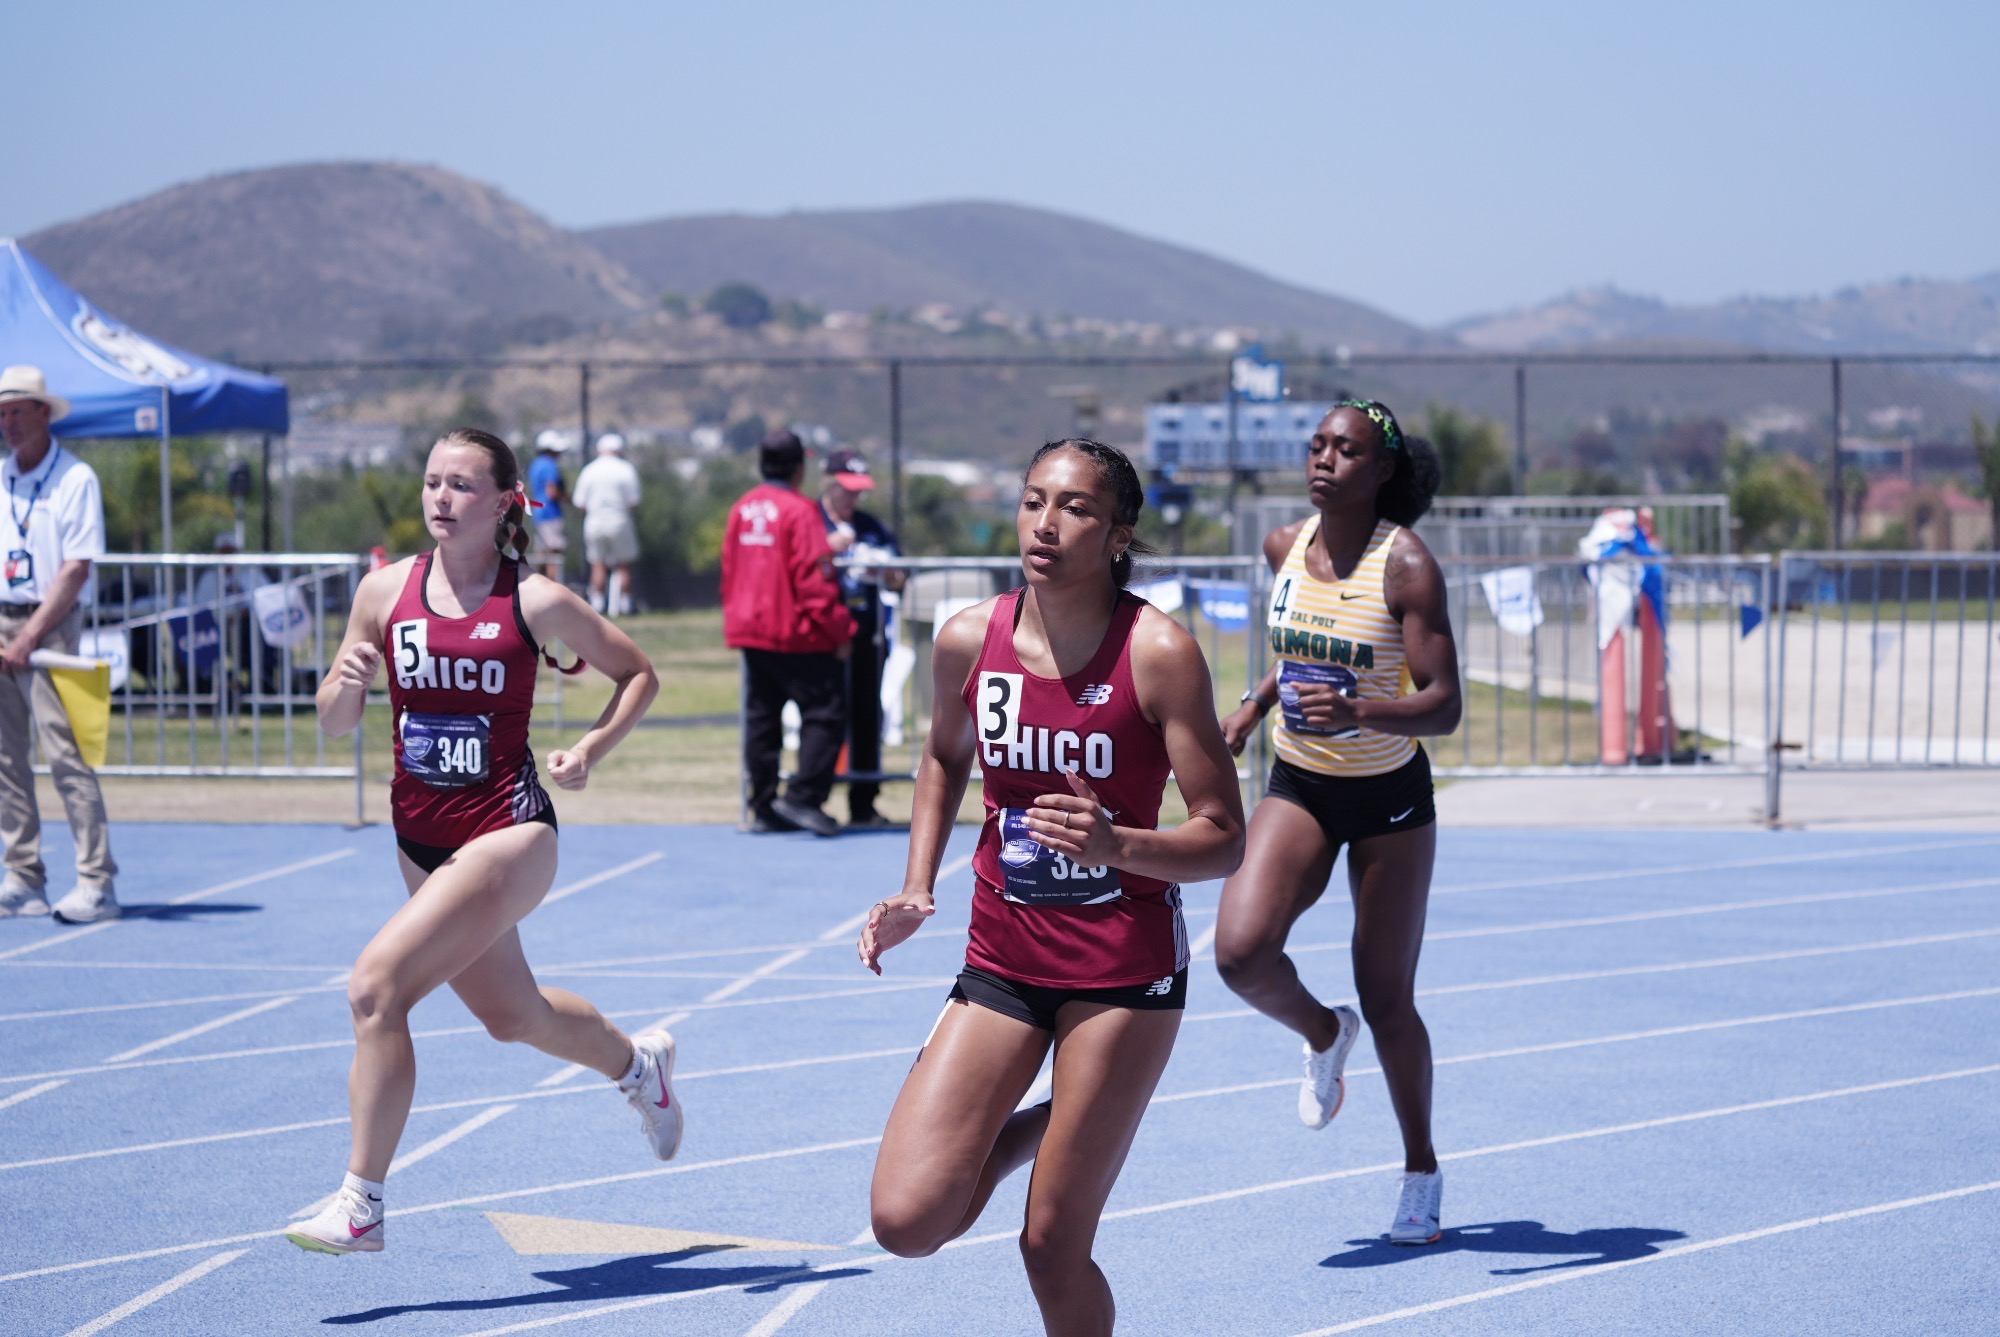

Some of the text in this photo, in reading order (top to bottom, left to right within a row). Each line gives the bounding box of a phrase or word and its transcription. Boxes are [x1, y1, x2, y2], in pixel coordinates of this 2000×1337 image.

[1273, 579, 1292, 621] 4
[1311, 615, 1337, 629] POLY
[400, 624, 420, 673] 5
[1268, 626, 1374, 670] OMONA
[984, 677, 1011, 740] 3
[437, 736, 482, 775] 340
